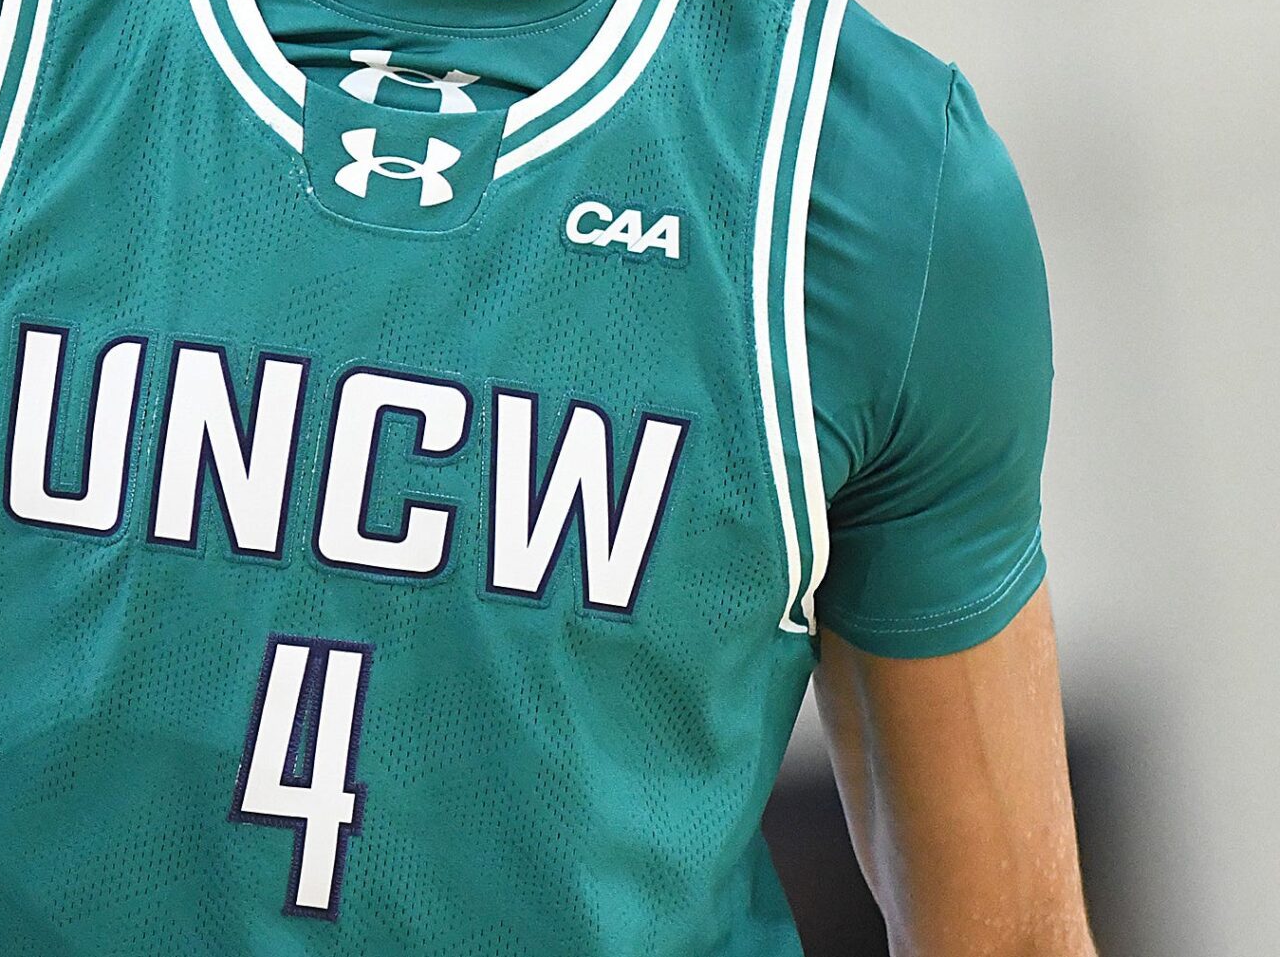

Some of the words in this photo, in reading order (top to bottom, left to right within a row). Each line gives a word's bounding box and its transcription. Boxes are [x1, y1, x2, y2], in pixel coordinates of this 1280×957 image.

[565, 200, 680, 260] CAA
[4, 323, 691, 615] UNCW
[229, 632, 375, 920] 4
